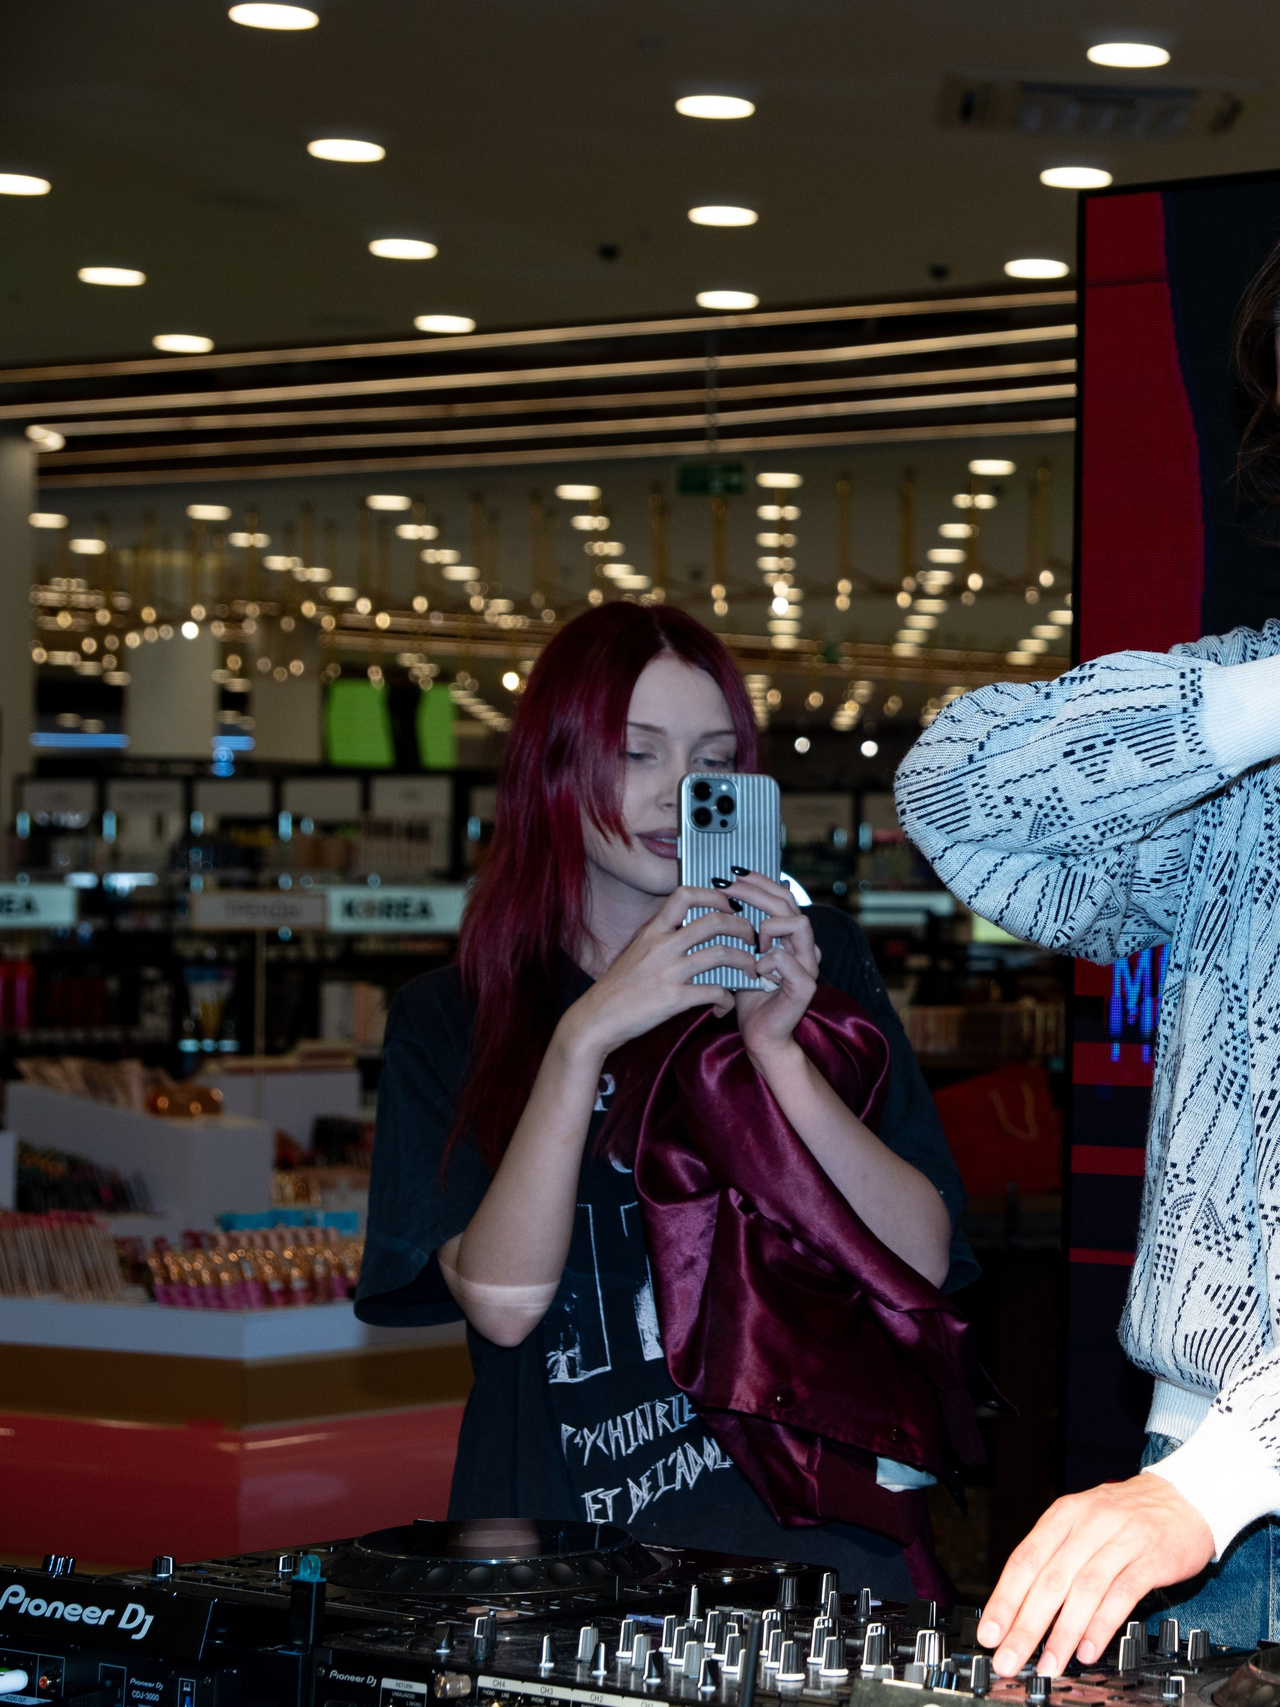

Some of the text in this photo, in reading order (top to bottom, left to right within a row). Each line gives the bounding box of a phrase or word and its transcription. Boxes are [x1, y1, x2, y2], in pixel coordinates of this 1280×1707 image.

[581, 1487, 622, 1524] ET
[0, 1584, 116, 1626] Pioneer
[329, 1669, 366, 1684] Pioneer
[129, 1677, 155, 1688] Pioneer
[395, 1681, 414, 1690] RETURN
[492, 1679, 506, 1689] CH4
[540, 1686, 554, 1696] CH3
[590, 1693, 604, 1703] CH2
